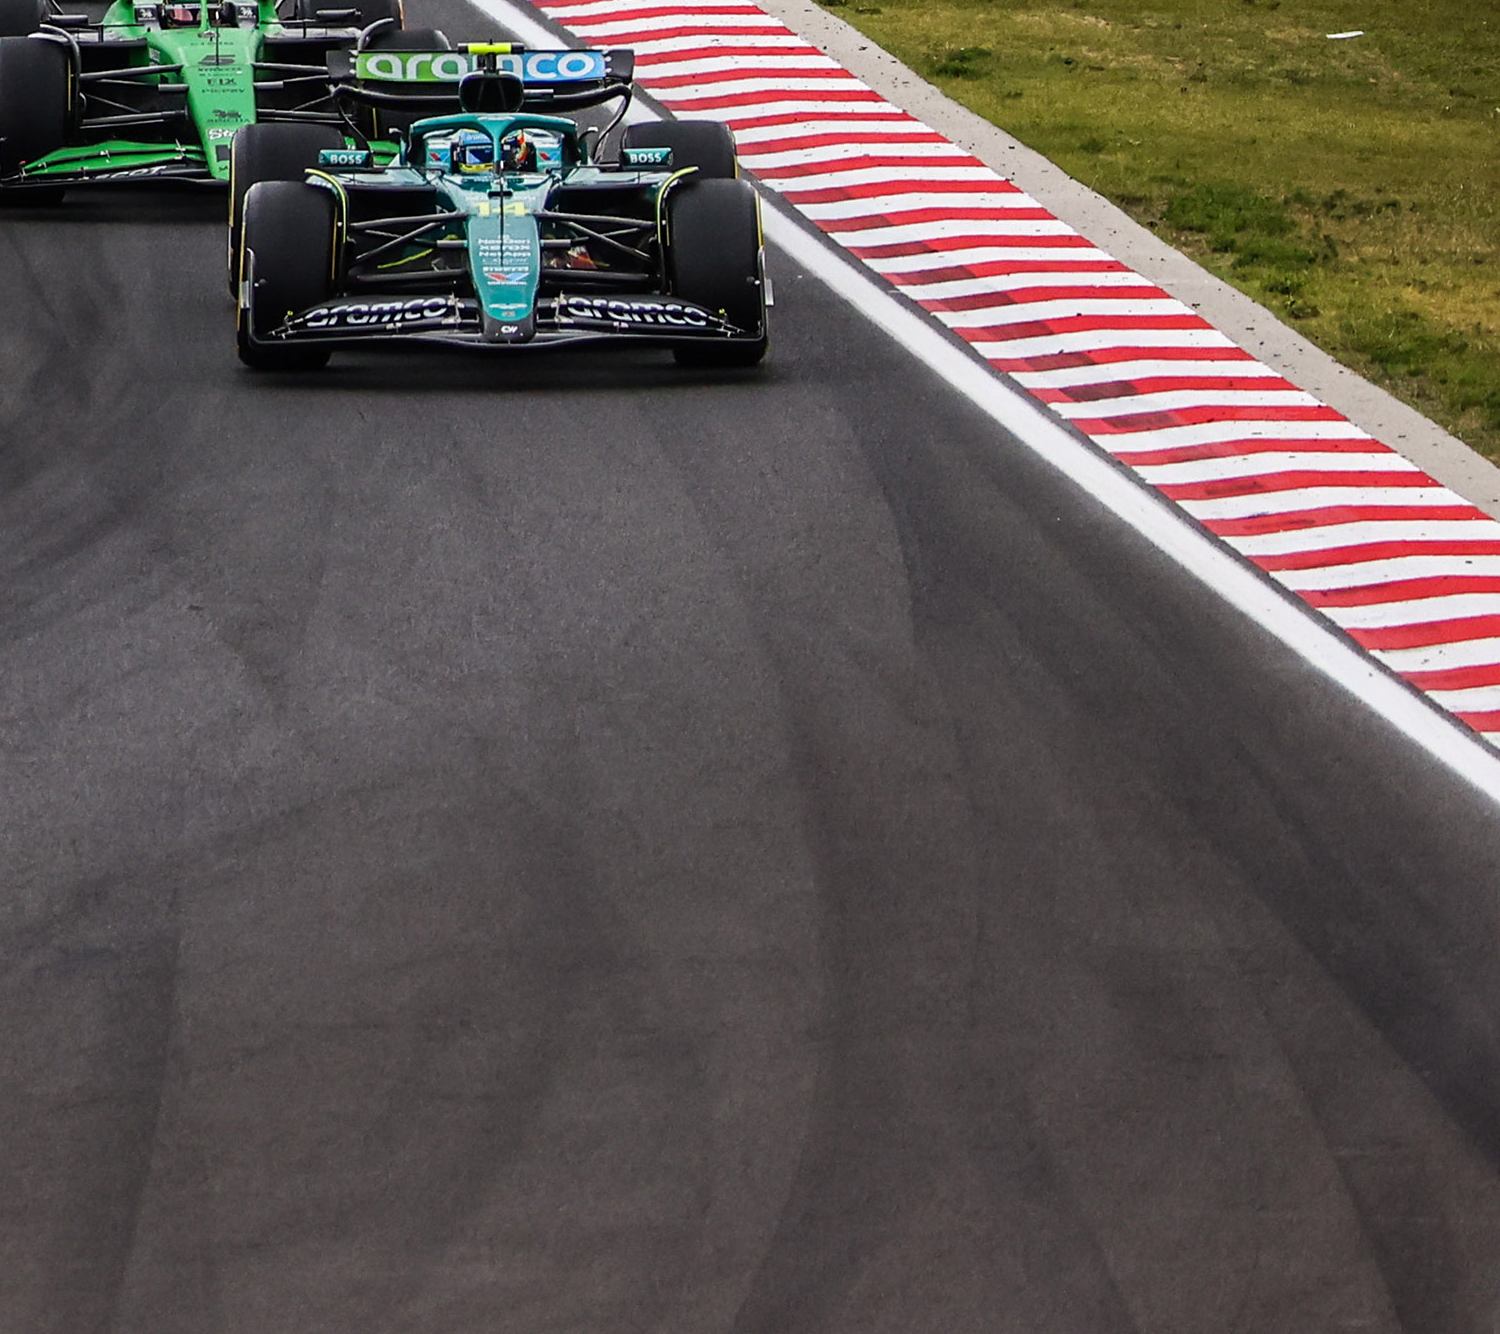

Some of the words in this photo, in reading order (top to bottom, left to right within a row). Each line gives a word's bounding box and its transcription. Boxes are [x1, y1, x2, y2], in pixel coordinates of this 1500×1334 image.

[365, 53, 595, 79] aramco
[330, 152, 363, 165] BOSS
[630, 152, 662, 164] BOSS
[473, 201, 530, 216] 14
[306, 297, 448, 328] aramco
[568, 297, 708, 326] aramco
